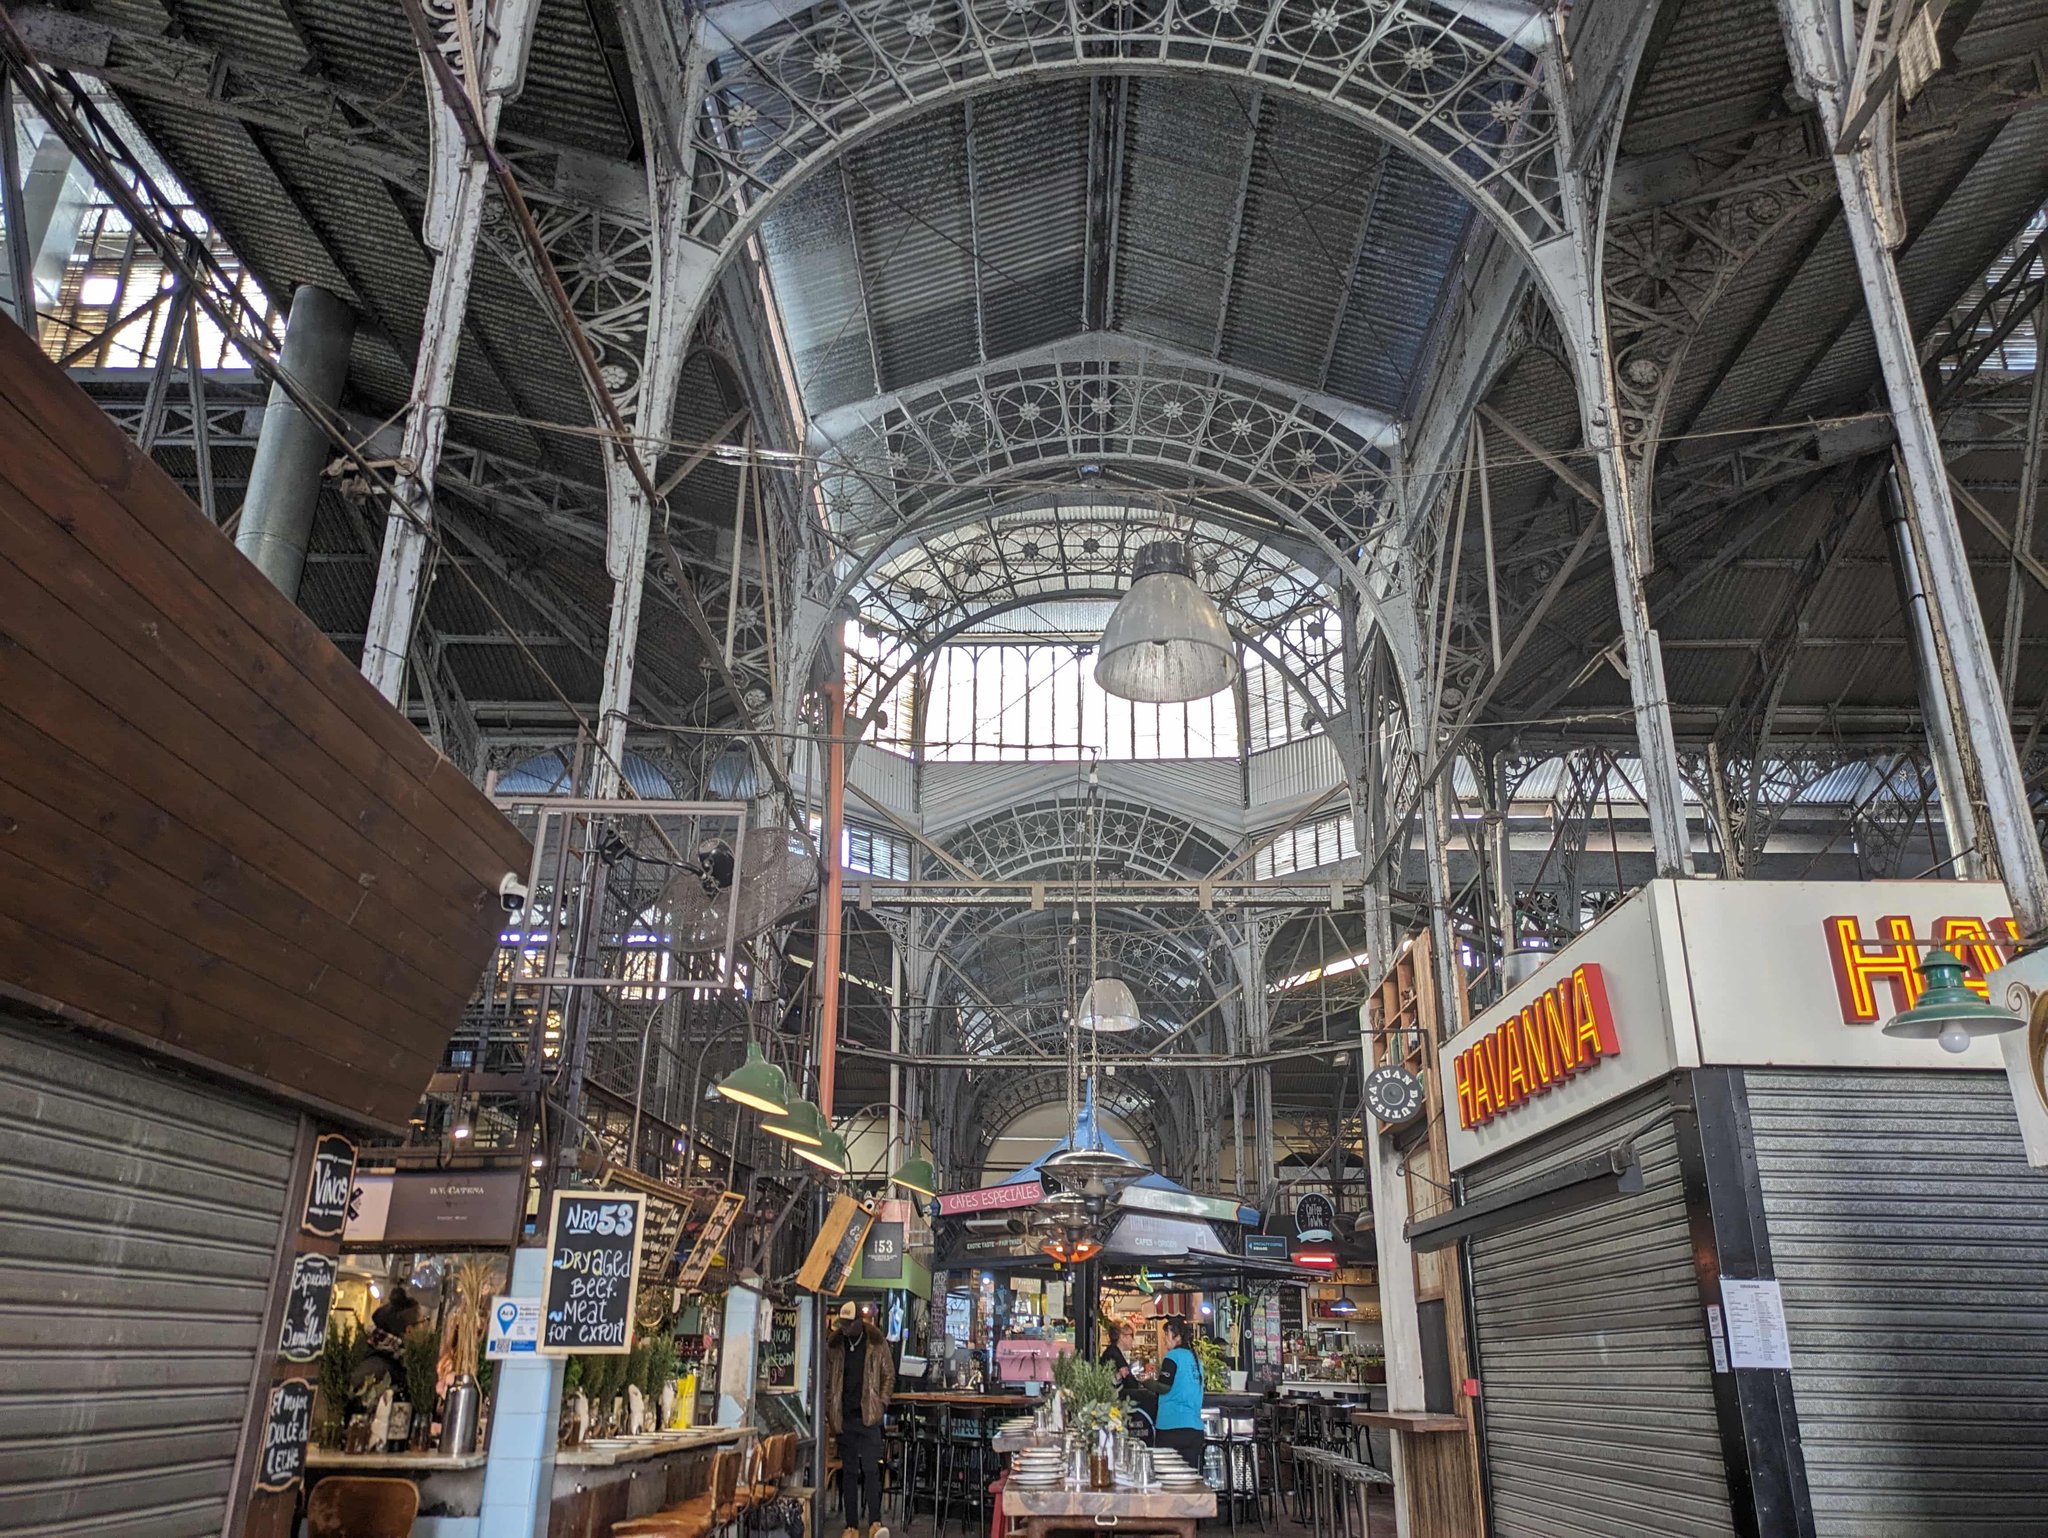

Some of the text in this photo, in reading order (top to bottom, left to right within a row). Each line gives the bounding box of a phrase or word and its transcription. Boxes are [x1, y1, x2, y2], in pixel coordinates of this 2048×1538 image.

[1824, 915, 2022, 1024] HA
[1454, 964, 1611, 1131] HAVANNA
[1375, 1069, 1413, 1086] JUAN
[1368, 1086, 1418, 1119] BAUTISTA
[981, 1184, 1041, 1207] ESPECIALES
